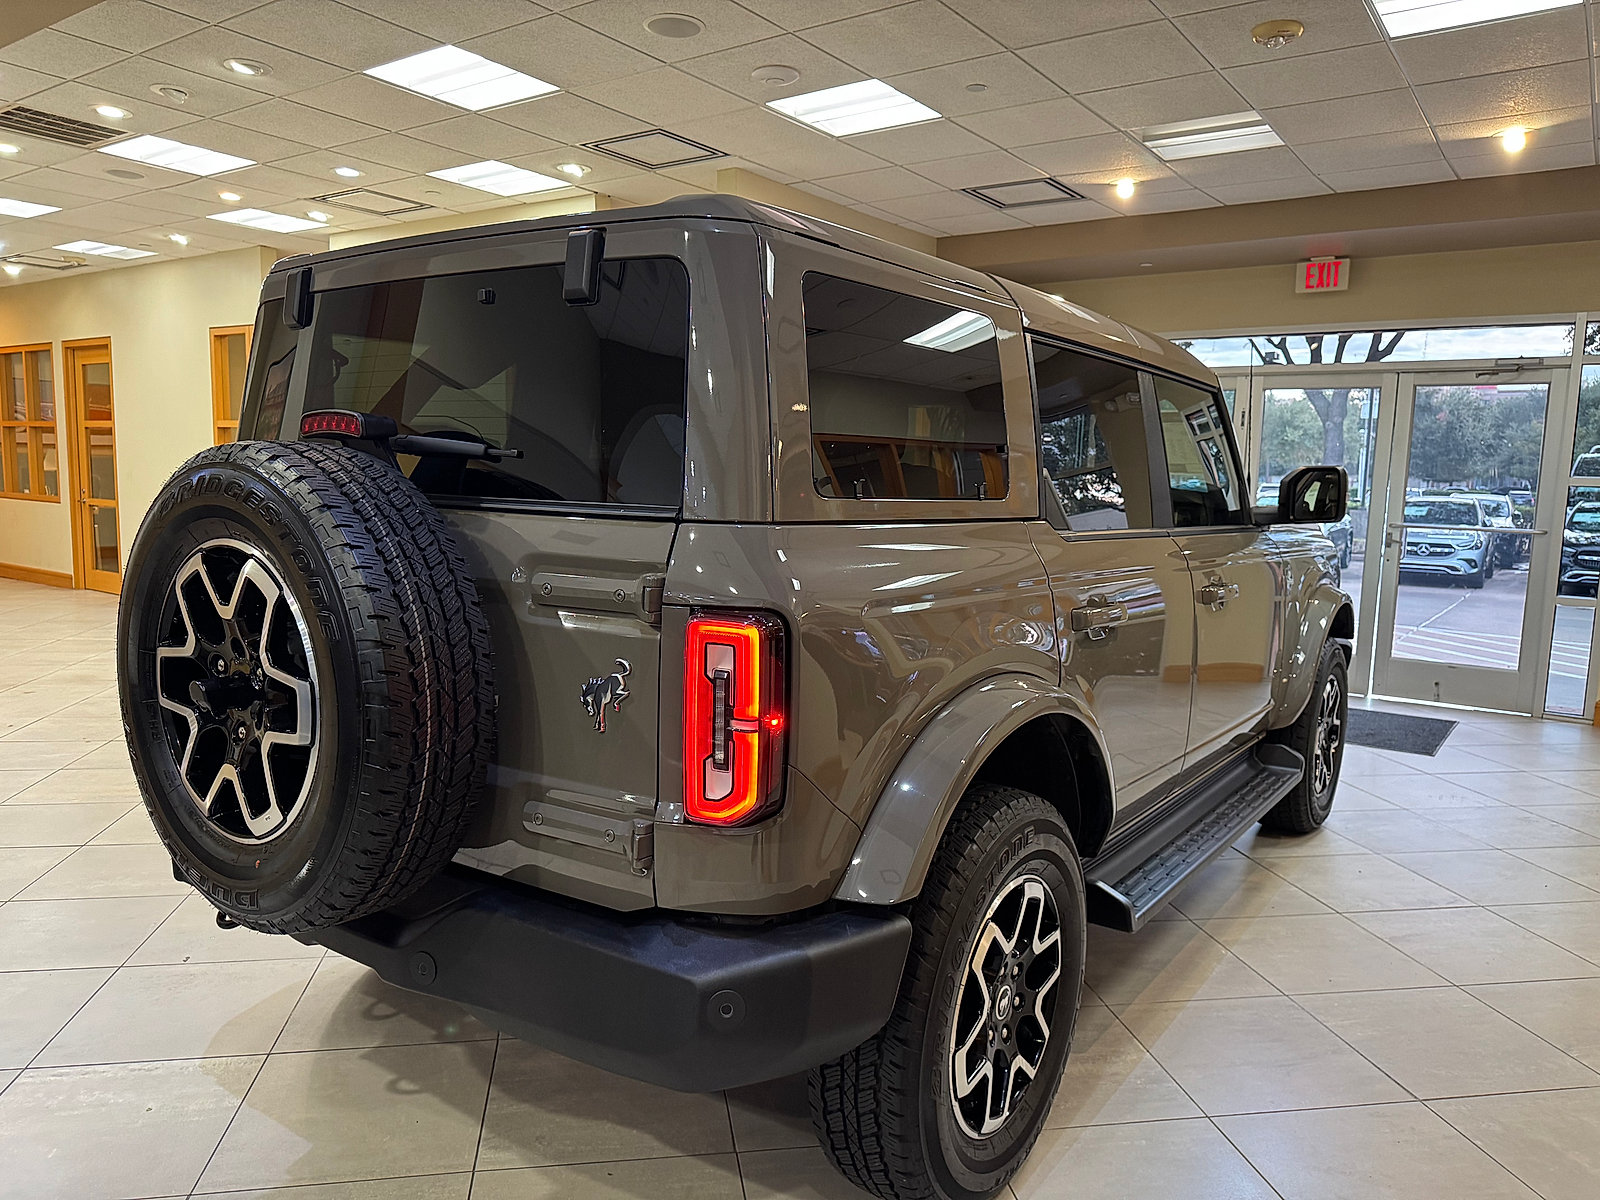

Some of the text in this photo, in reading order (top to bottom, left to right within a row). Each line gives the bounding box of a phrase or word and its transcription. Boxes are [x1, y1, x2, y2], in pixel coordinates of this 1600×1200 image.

[1305, 261, 1342, 289] EXIT
[159, 473, 341, 641] BRIDGESTONE
[928, 826, 1036, 1098] BRIDGESTONE
